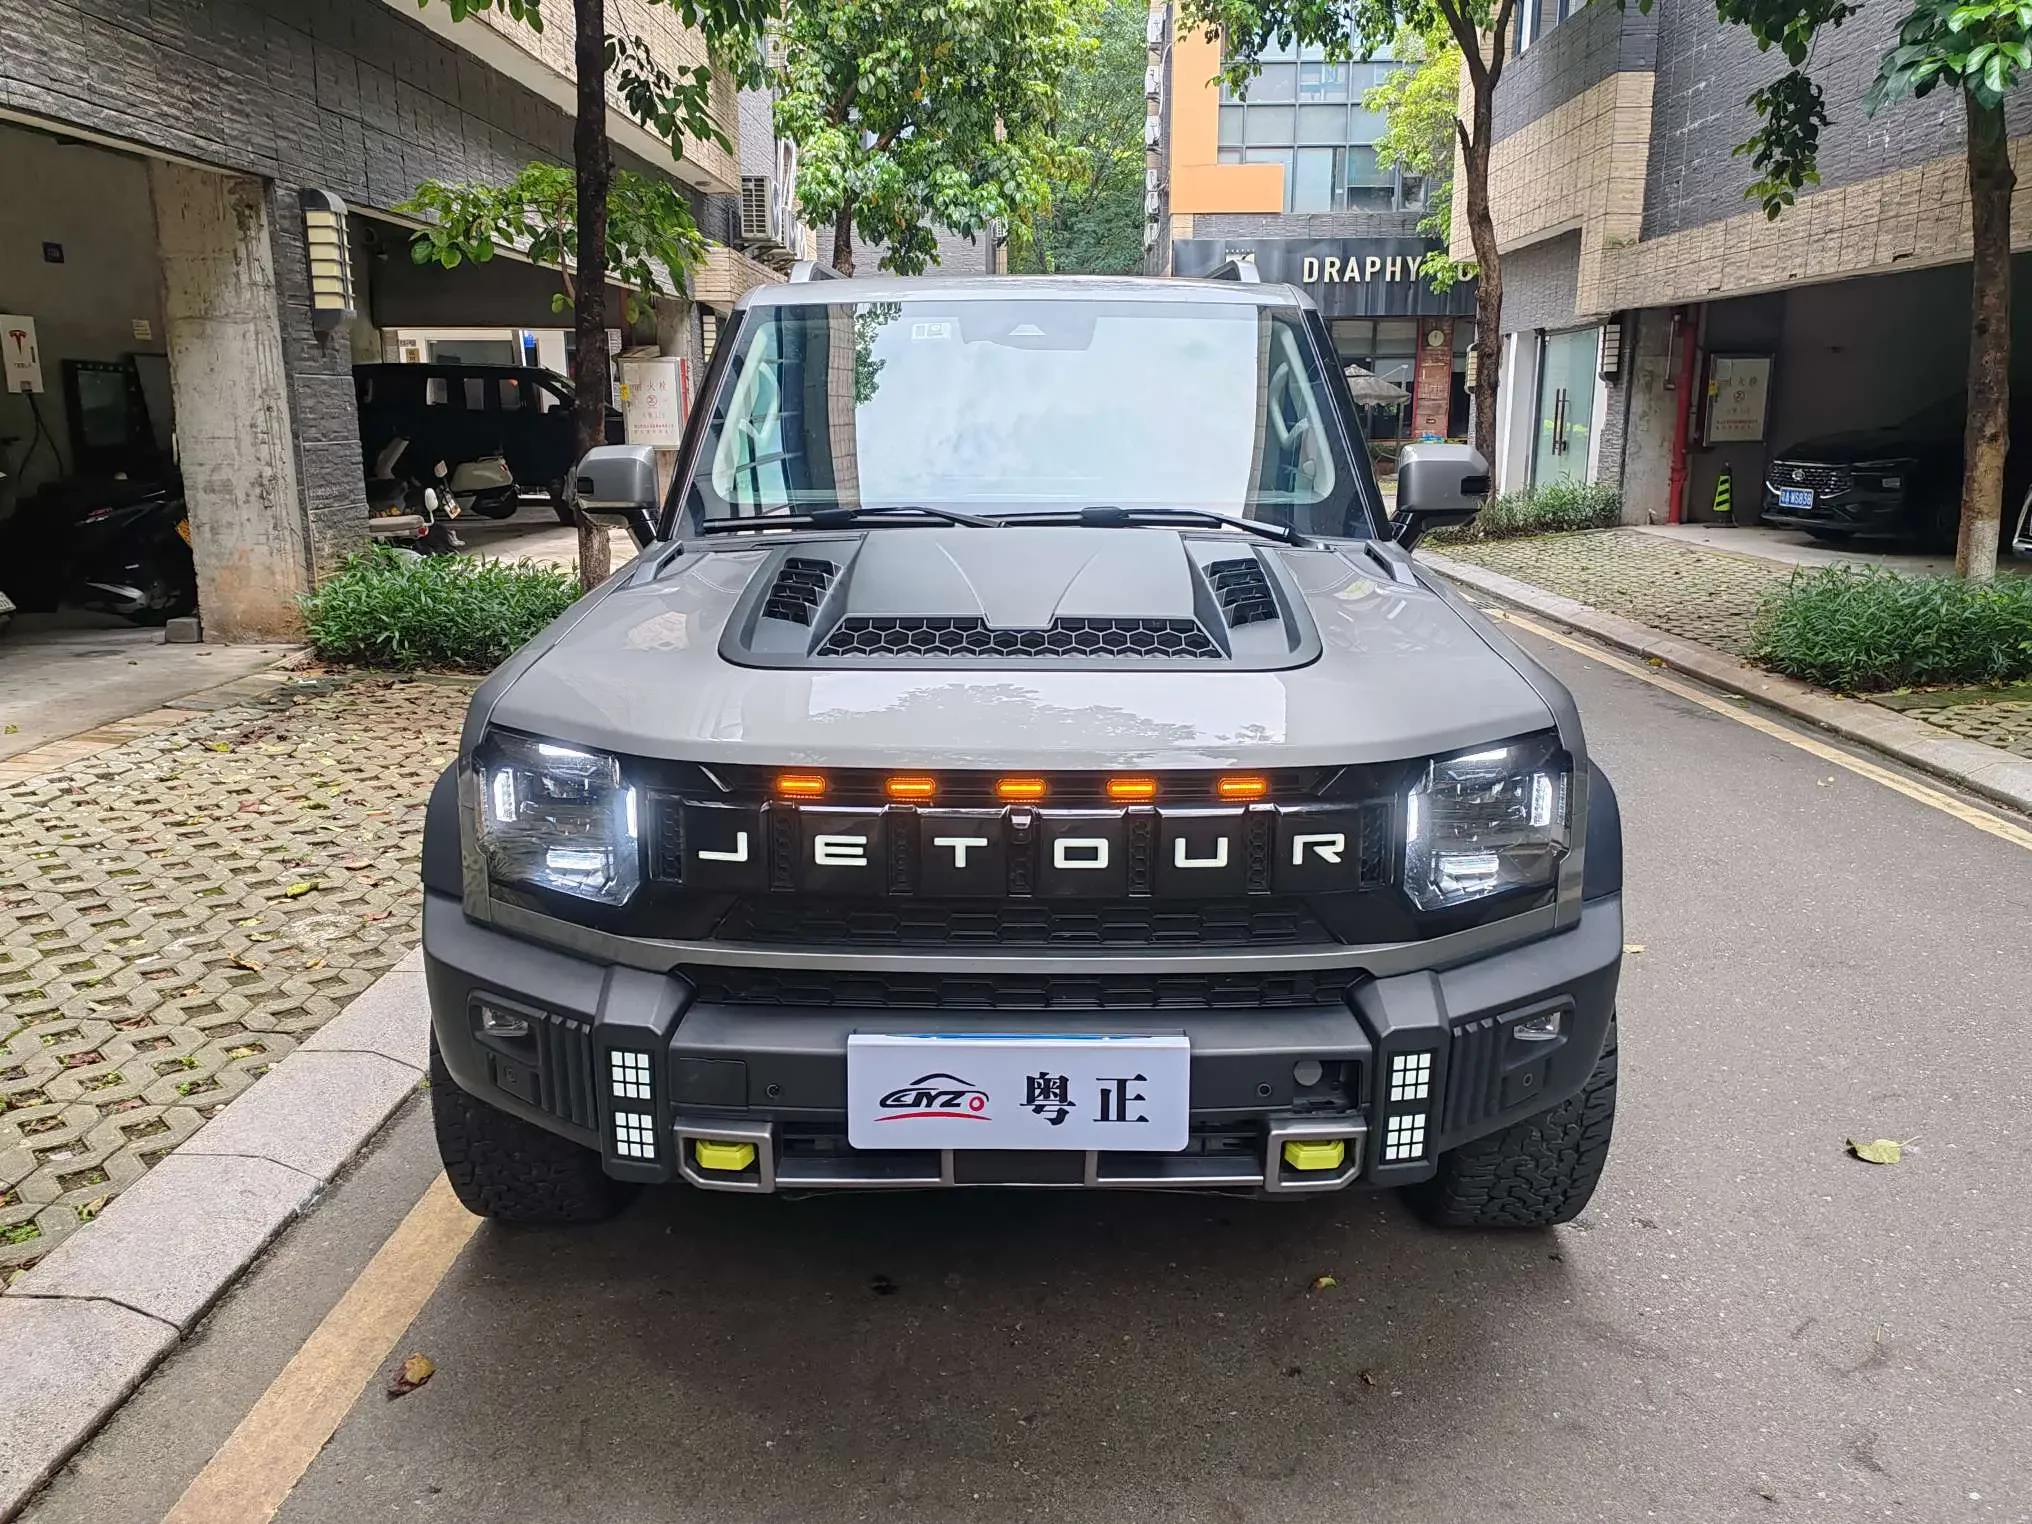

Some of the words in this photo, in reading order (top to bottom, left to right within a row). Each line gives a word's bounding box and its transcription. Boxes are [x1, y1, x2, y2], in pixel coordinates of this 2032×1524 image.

[1303, 256, 1423, 283] DRAPHY
[698, 832, 1346, 869] JETOUR
[1019, 1071, 1150, 1126] 粤正
